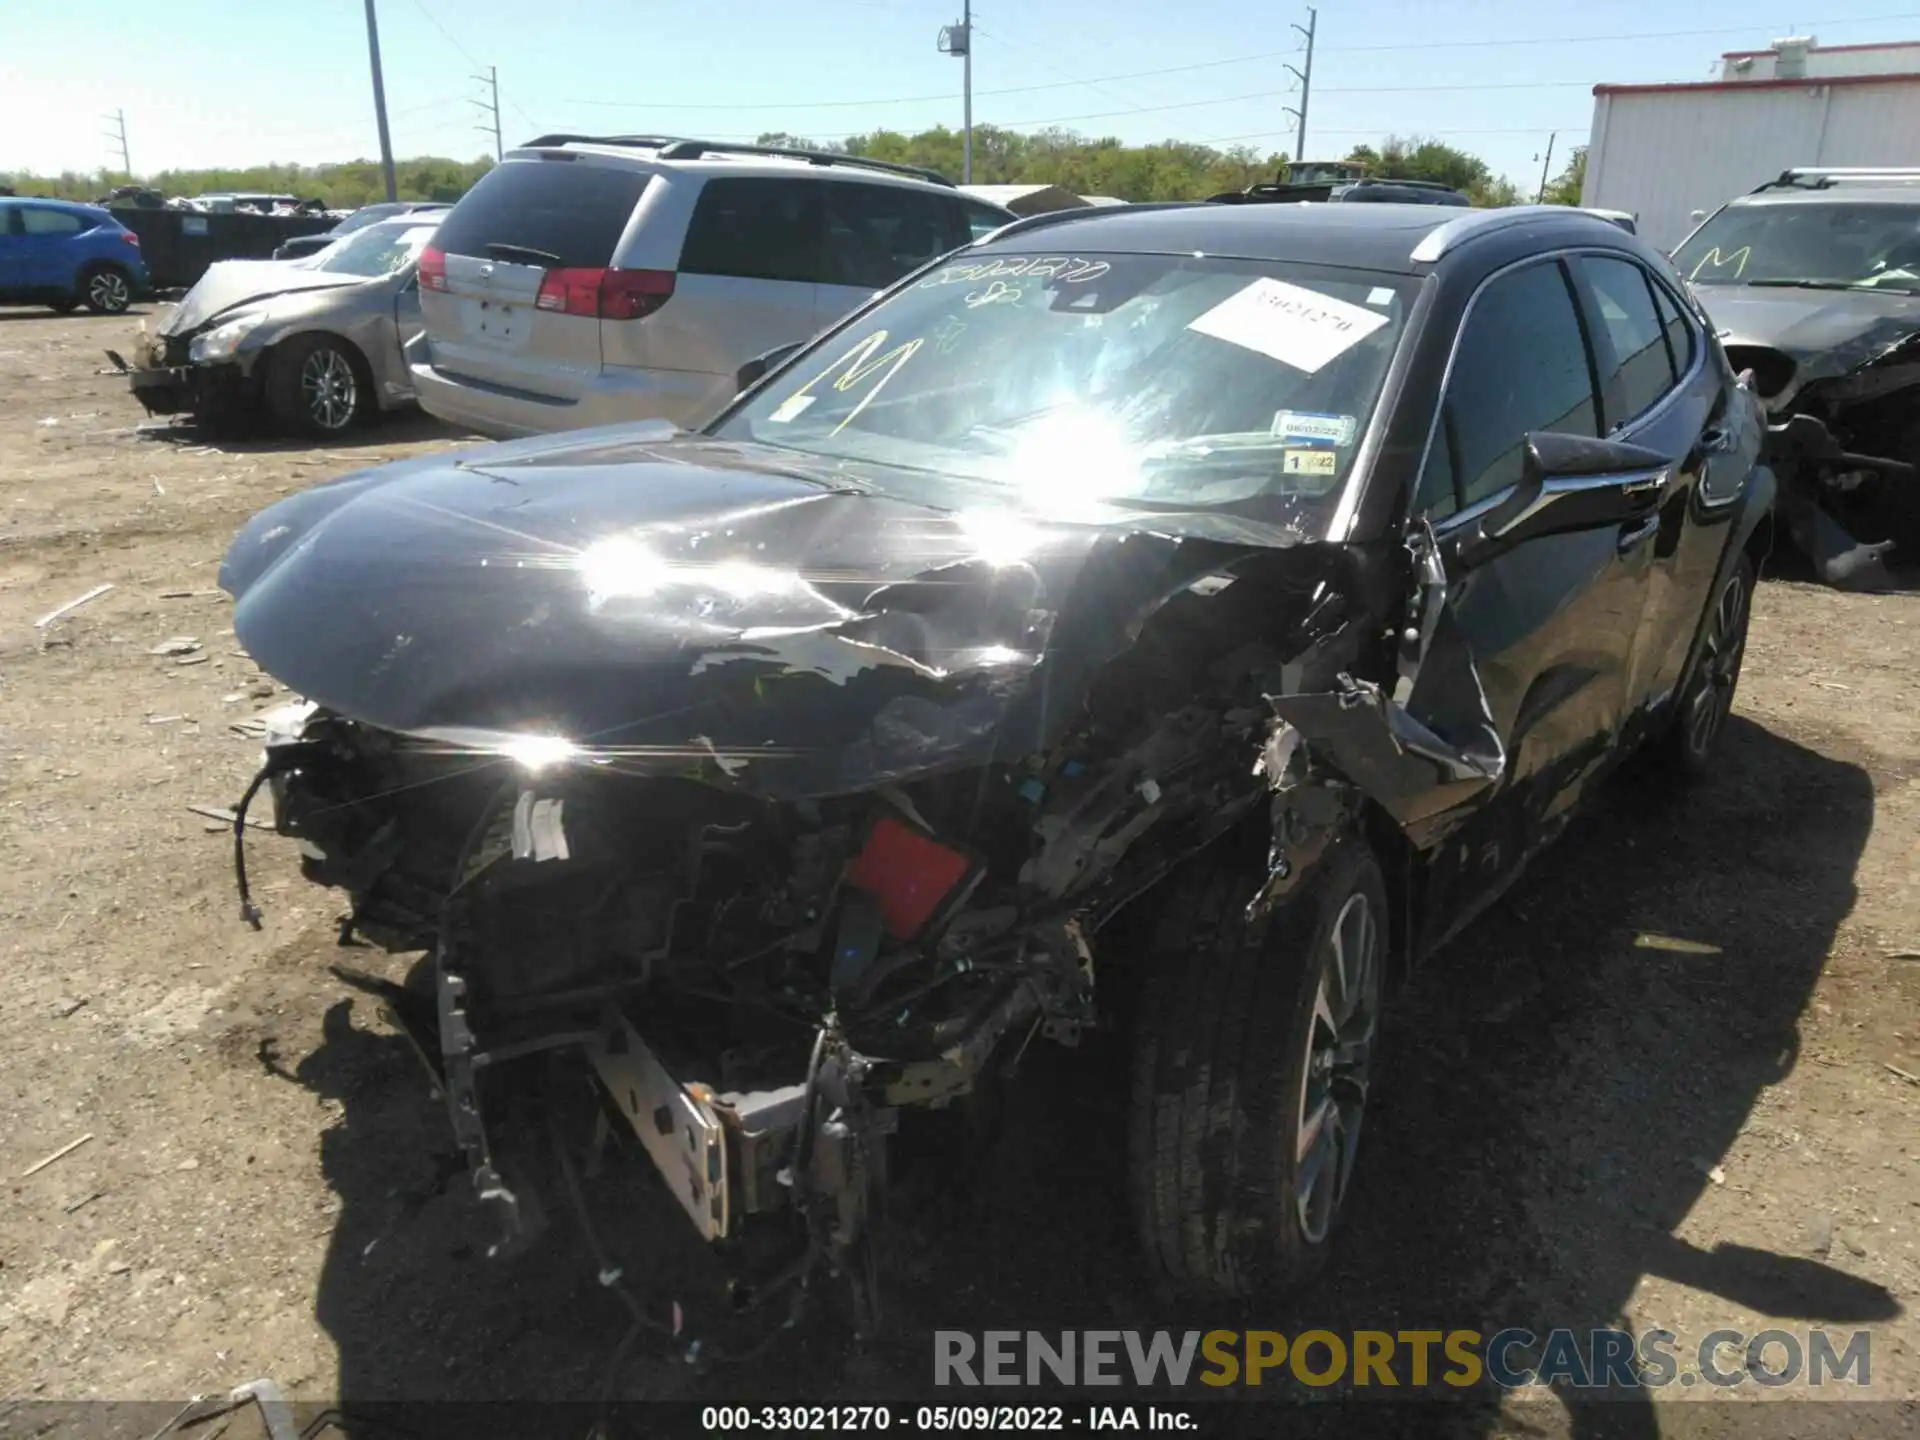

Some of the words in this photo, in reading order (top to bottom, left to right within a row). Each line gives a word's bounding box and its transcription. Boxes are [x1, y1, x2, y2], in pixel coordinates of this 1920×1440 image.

[1690, 245, 1751, 281] M
[783, 329, 925, 439] M
[1289, 455, 1300, 470] 1
